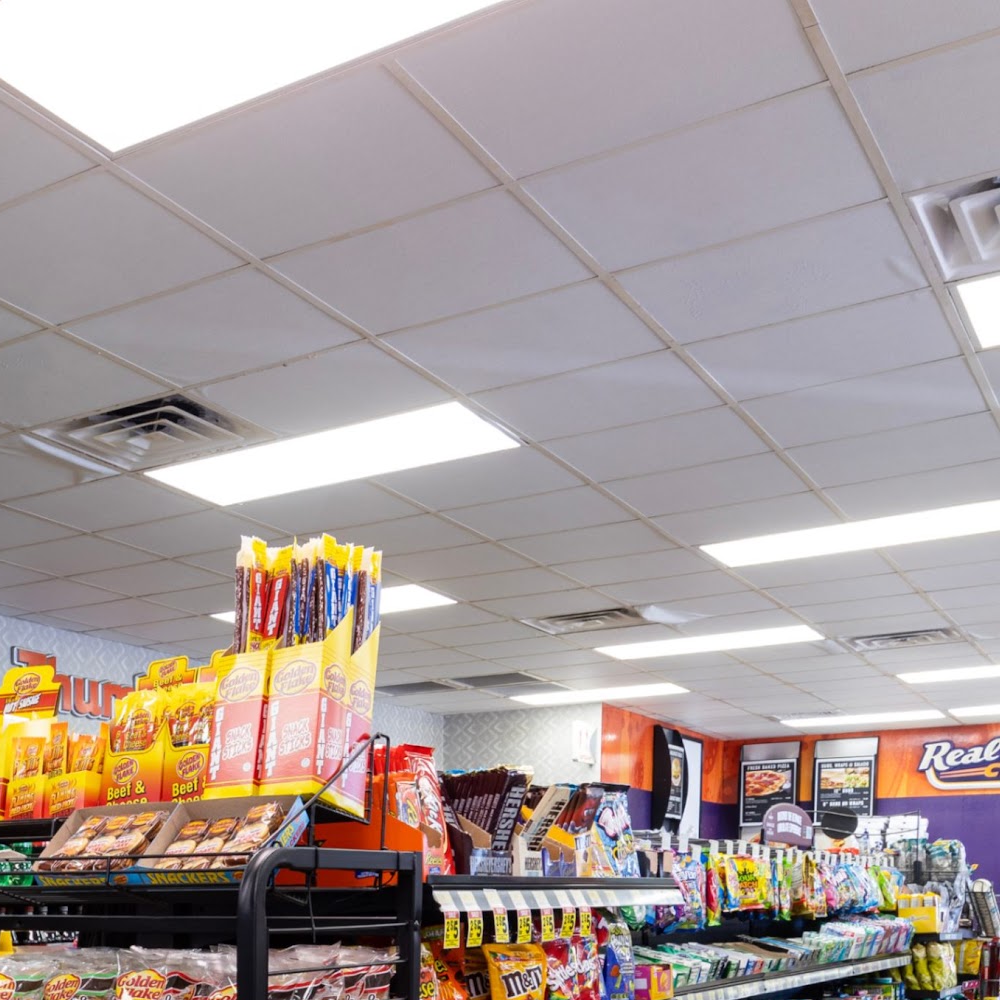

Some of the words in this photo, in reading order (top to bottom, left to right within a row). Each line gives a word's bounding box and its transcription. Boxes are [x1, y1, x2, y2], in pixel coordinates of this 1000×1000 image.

[918, 737, 1000, 771] Real
[107, 781, 131, 800] Beef
[135, 780, 146, 794] &
[172, 778, 199, 798] Beef
[492, 785, 525, 851] HERSHE
[118, 972, 166, 989] Golden
